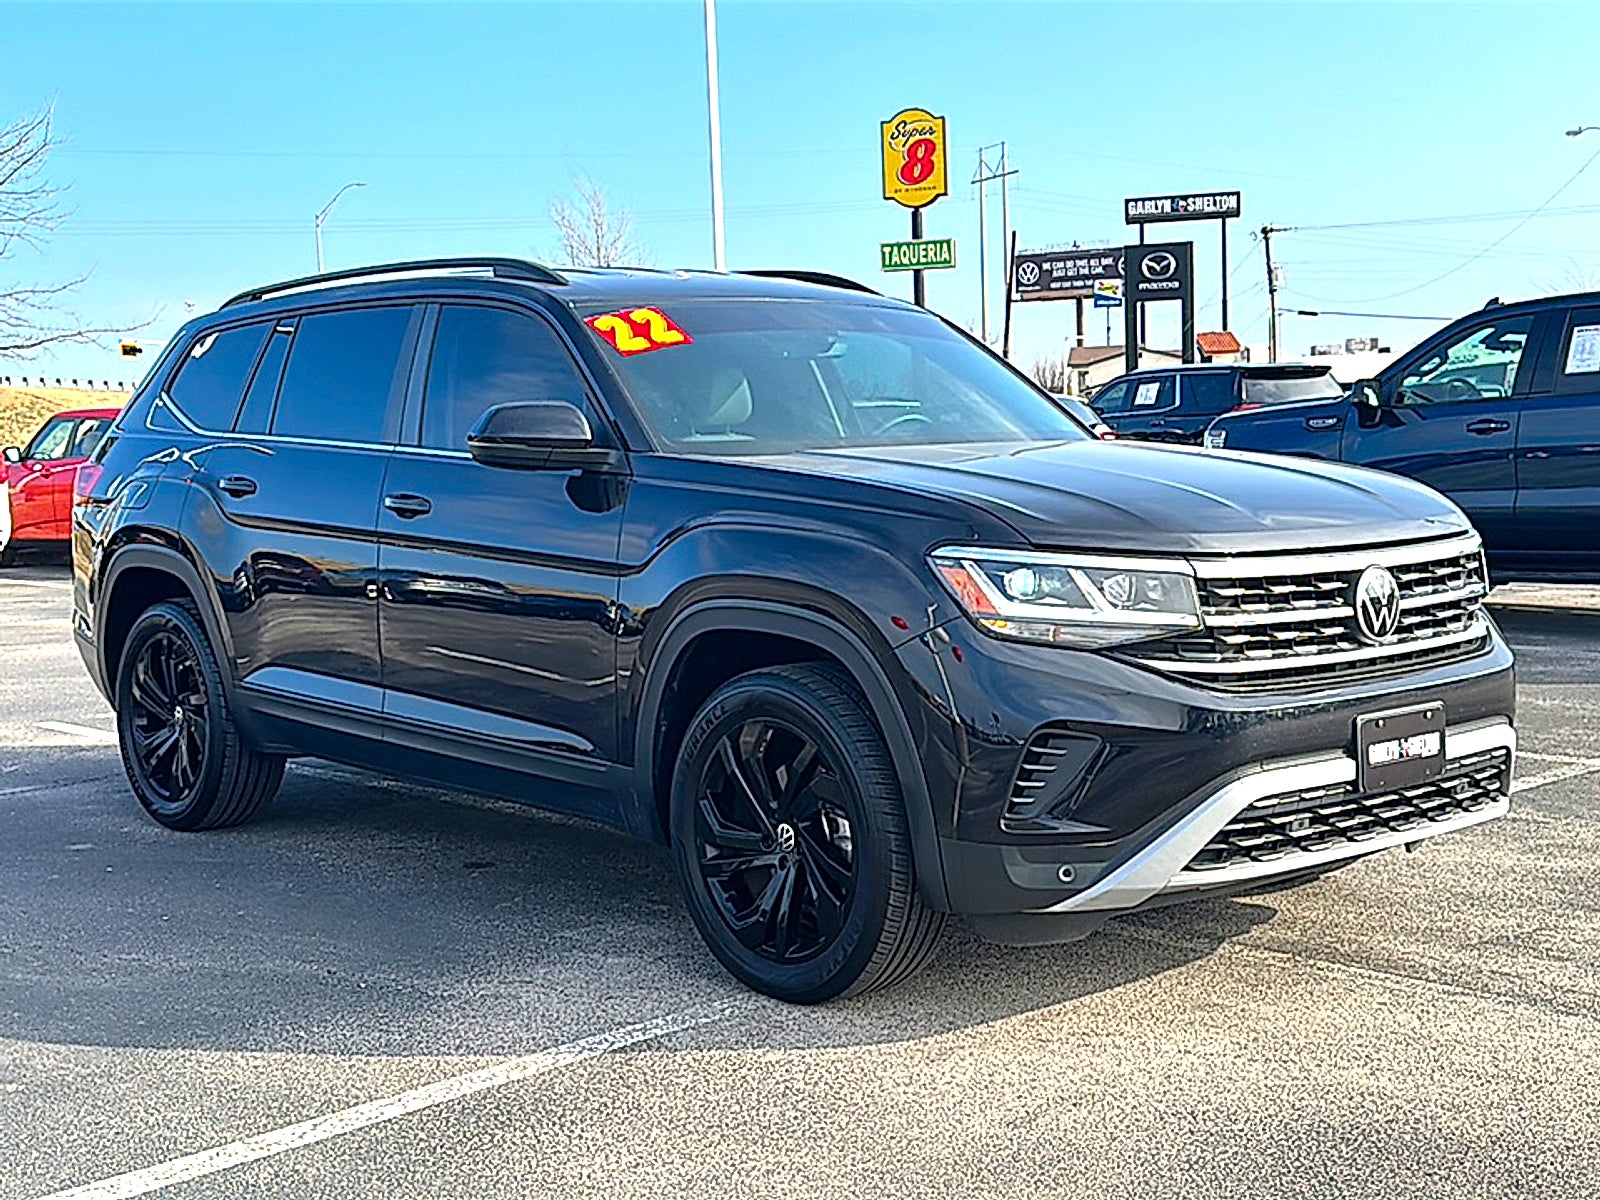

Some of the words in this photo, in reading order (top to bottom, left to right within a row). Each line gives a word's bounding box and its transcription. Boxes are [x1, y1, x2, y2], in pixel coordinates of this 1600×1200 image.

[890, 119, 937, 148] Super
[899, 138, 937, 185] 8
[1186, 195, 1237, 212] SHELTON
[882, 242, 950, 265] TAQUERIA
[1138, 281, 1179, 291] mazda
[593, 308, 685, 352] 22
